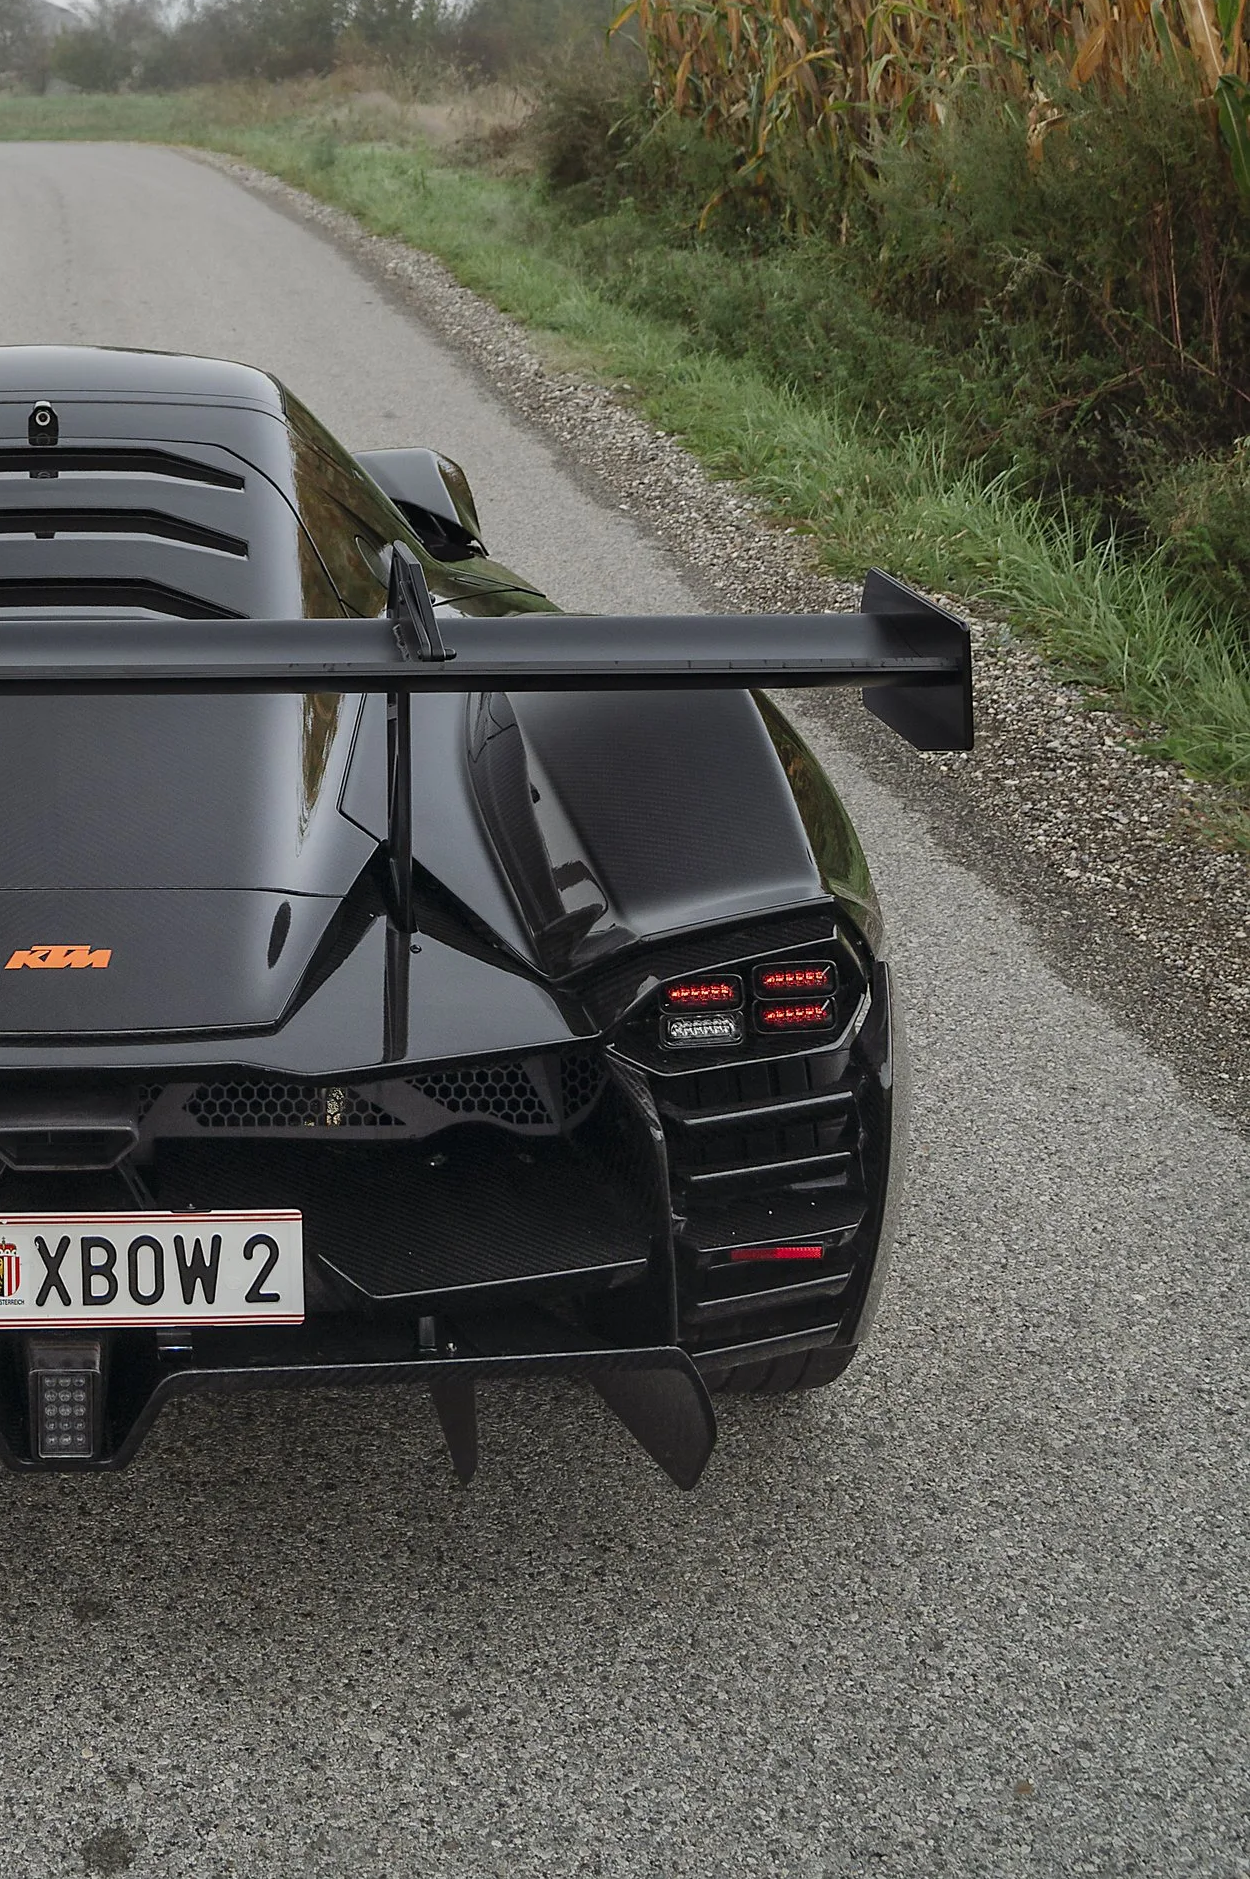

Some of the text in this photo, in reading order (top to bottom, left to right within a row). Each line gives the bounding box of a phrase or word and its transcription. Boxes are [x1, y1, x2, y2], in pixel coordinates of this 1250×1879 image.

[4, 945, 112, 969] KTM
[34, 1234, 223, 1307] XBOW
[242, 1234, 281, 1303] 2
